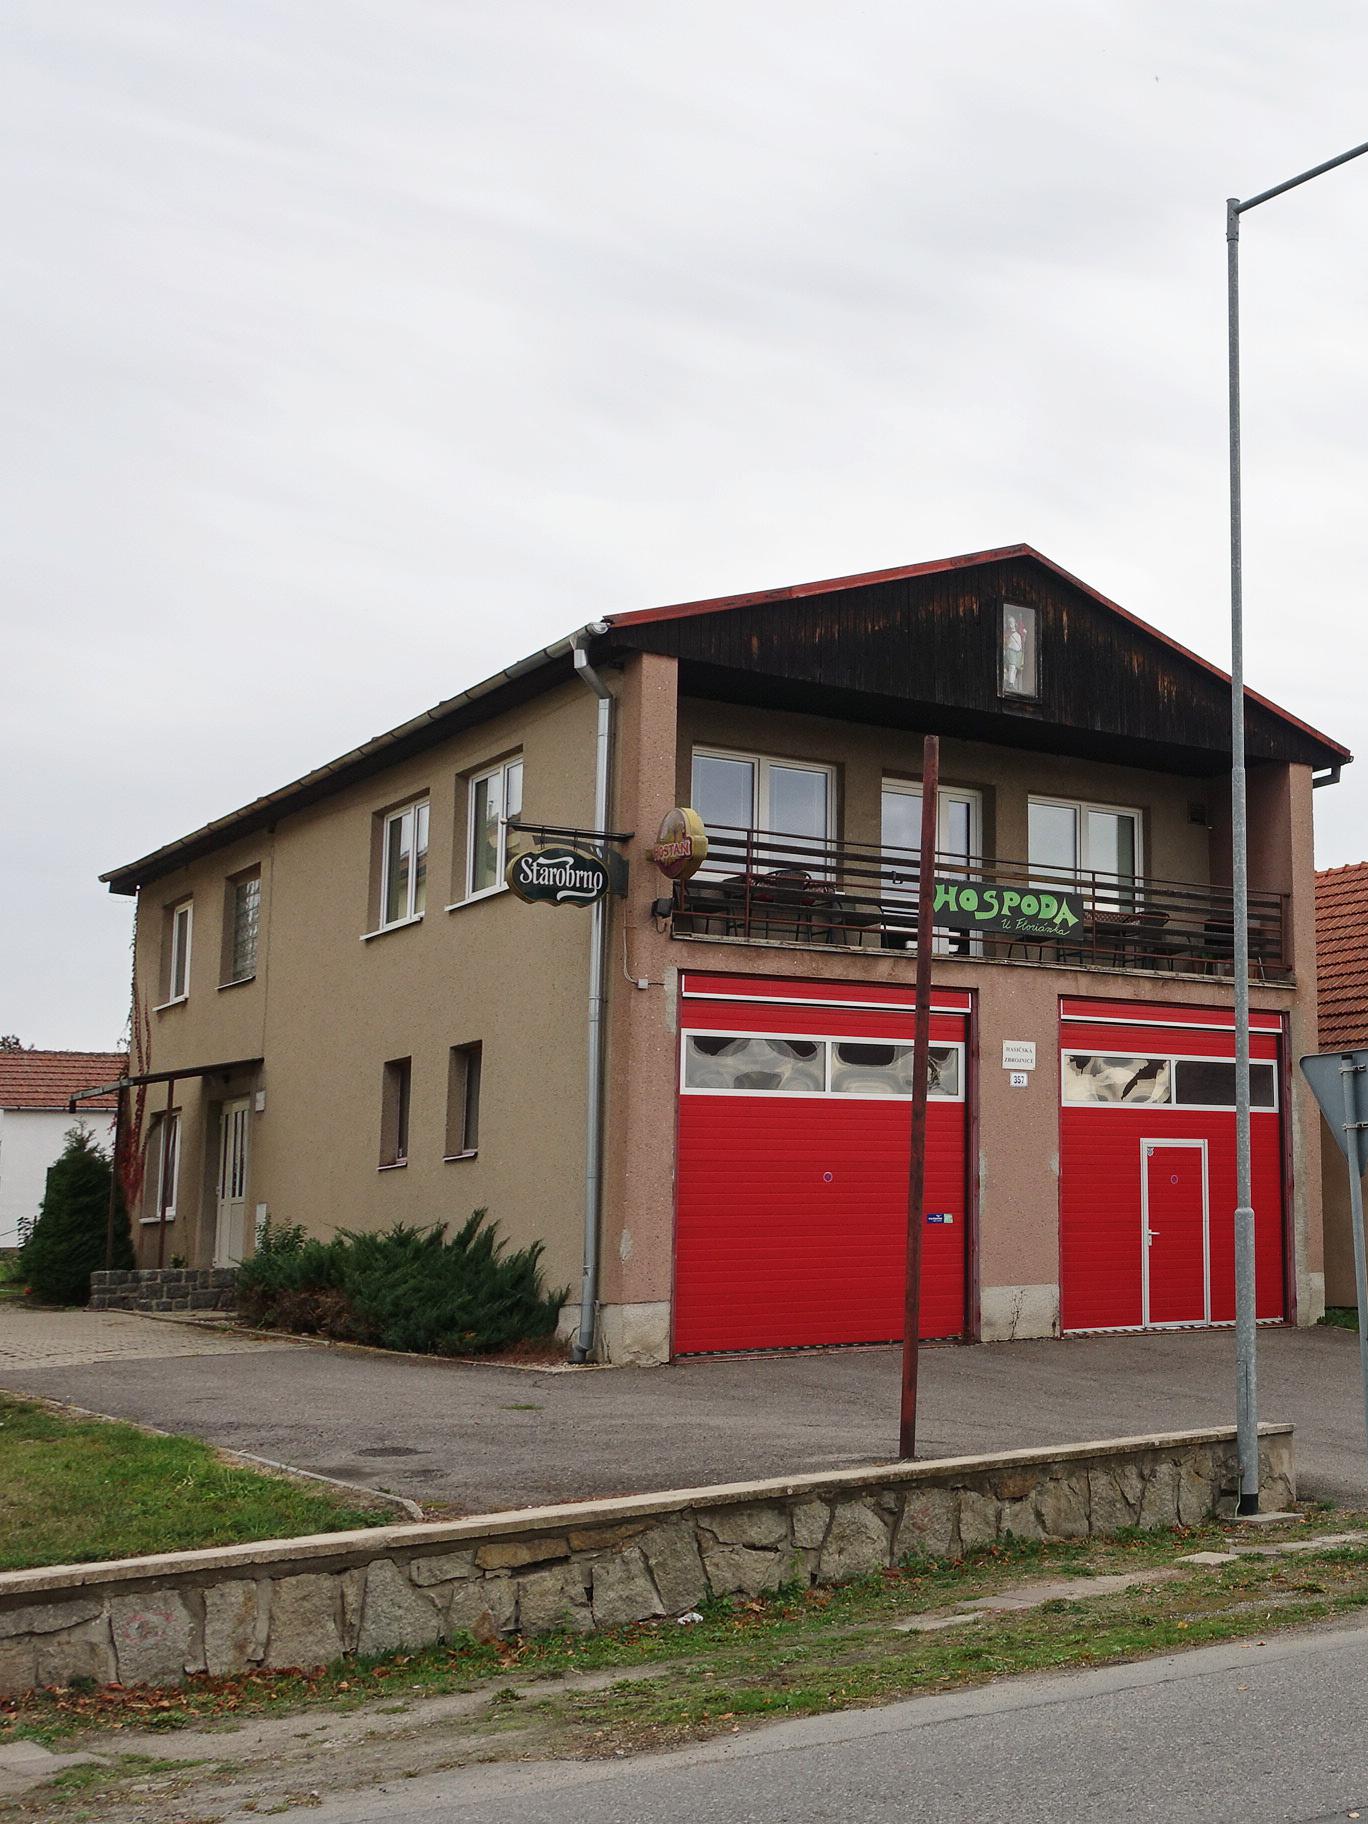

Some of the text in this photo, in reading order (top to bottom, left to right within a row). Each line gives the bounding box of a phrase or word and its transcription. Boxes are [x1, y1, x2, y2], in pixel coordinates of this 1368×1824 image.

[519, 856, 603, 900] Starobrno
[933, 884, 1080, 928] HOSPODA
[1013, 1075, 1025, 1084] 357
